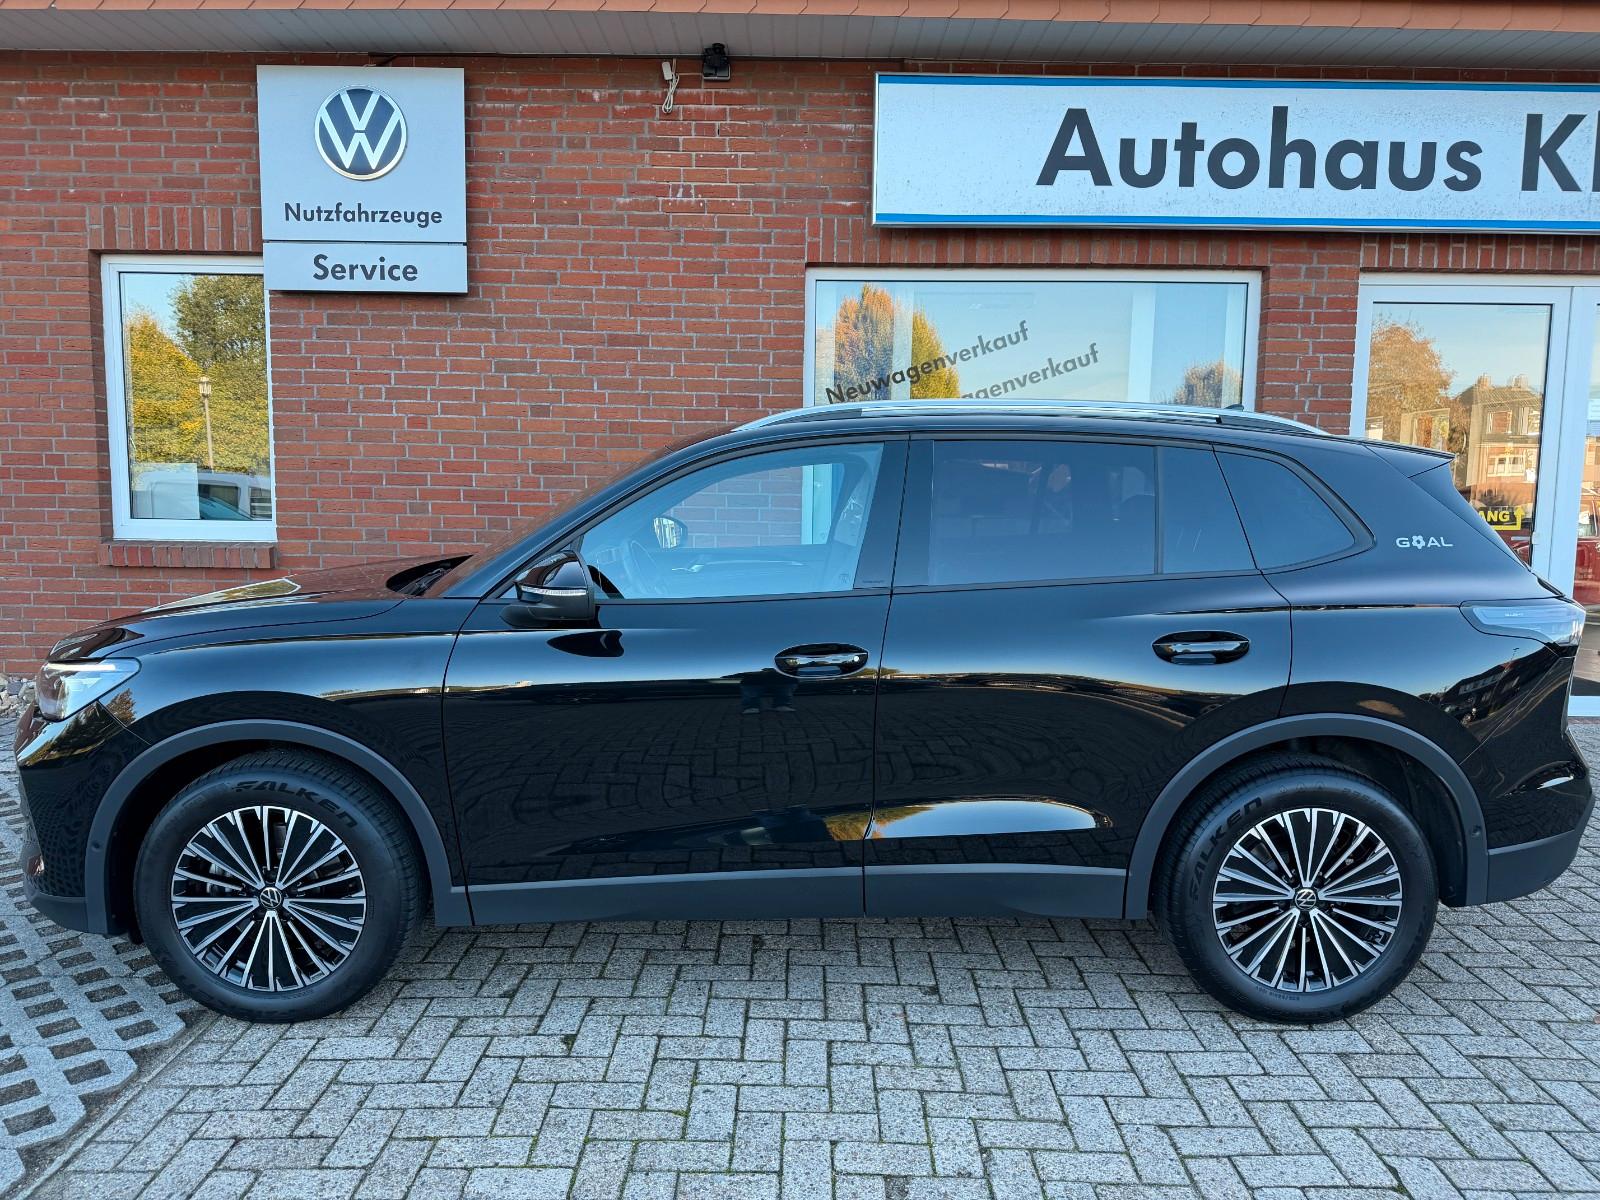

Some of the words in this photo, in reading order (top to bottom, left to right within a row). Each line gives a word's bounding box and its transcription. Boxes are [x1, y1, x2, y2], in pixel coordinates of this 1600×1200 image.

[314, 85, 408, 181] VW
[1036, 105, 1483, 190] Autohaus
[284, 202, 442, 228] Nutzfahrzeuge
[313, 254, 418, 281] Service
[825, 320, 1029, 405] Neuwagenverkauf
[1395, 535, 1453, 550] GOAL
